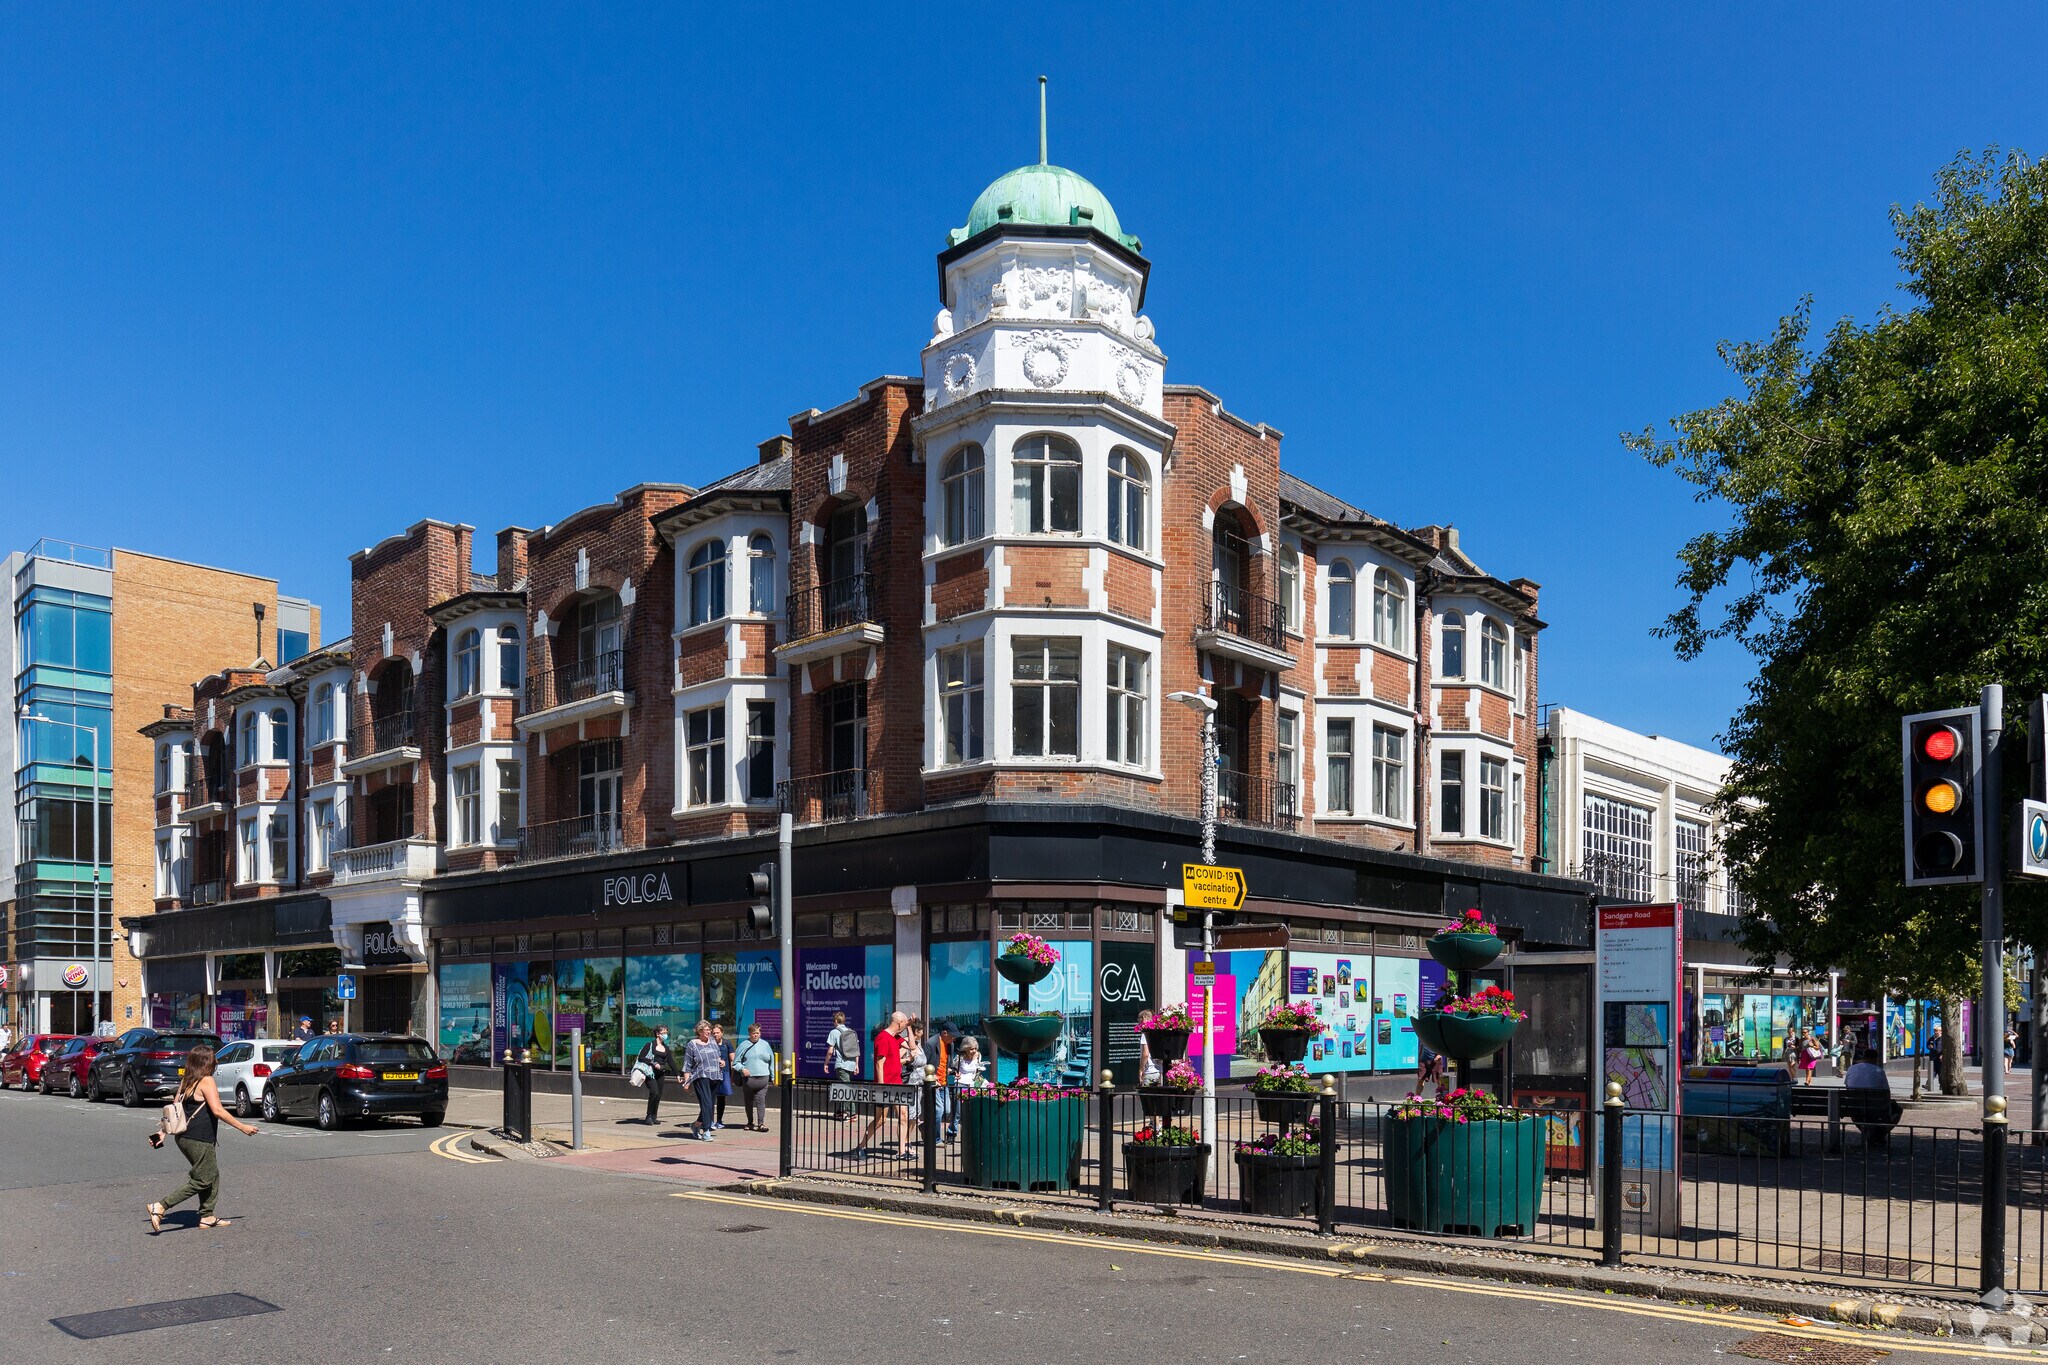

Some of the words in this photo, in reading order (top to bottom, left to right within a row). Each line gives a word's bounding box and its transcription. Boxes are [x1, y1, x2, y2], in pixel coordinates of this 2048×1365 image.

[1196, 868, 1234, 880] COVID-19
[604, 872, 672, 906] FOLCA
[1194, 882, 1236, 893] vaccination
[1986, 888, 1994, 897] 7
[1203, 896, 1226, 904] centre
[1604, 912, 1633, 920] Sandgate
[711, 964, 727, 973] STEP
[728, 963, 746, 973] BACK
[748, 963, 755, 972] IN
[756, 962, 772, 972] TIME
[68, 968, 85, 982] KING
[806, 971, 880, 990] Folkestone
[221, 1011, 244, 1020] CELEBRATE
[636, 1008, 663, 1016] COUNTRY
[221, 1023, 237, 1032] WHAT'S
[832, 1088, 876, 1102] BOUVERIE
[883, 1091, 912, 1103] PLACE
